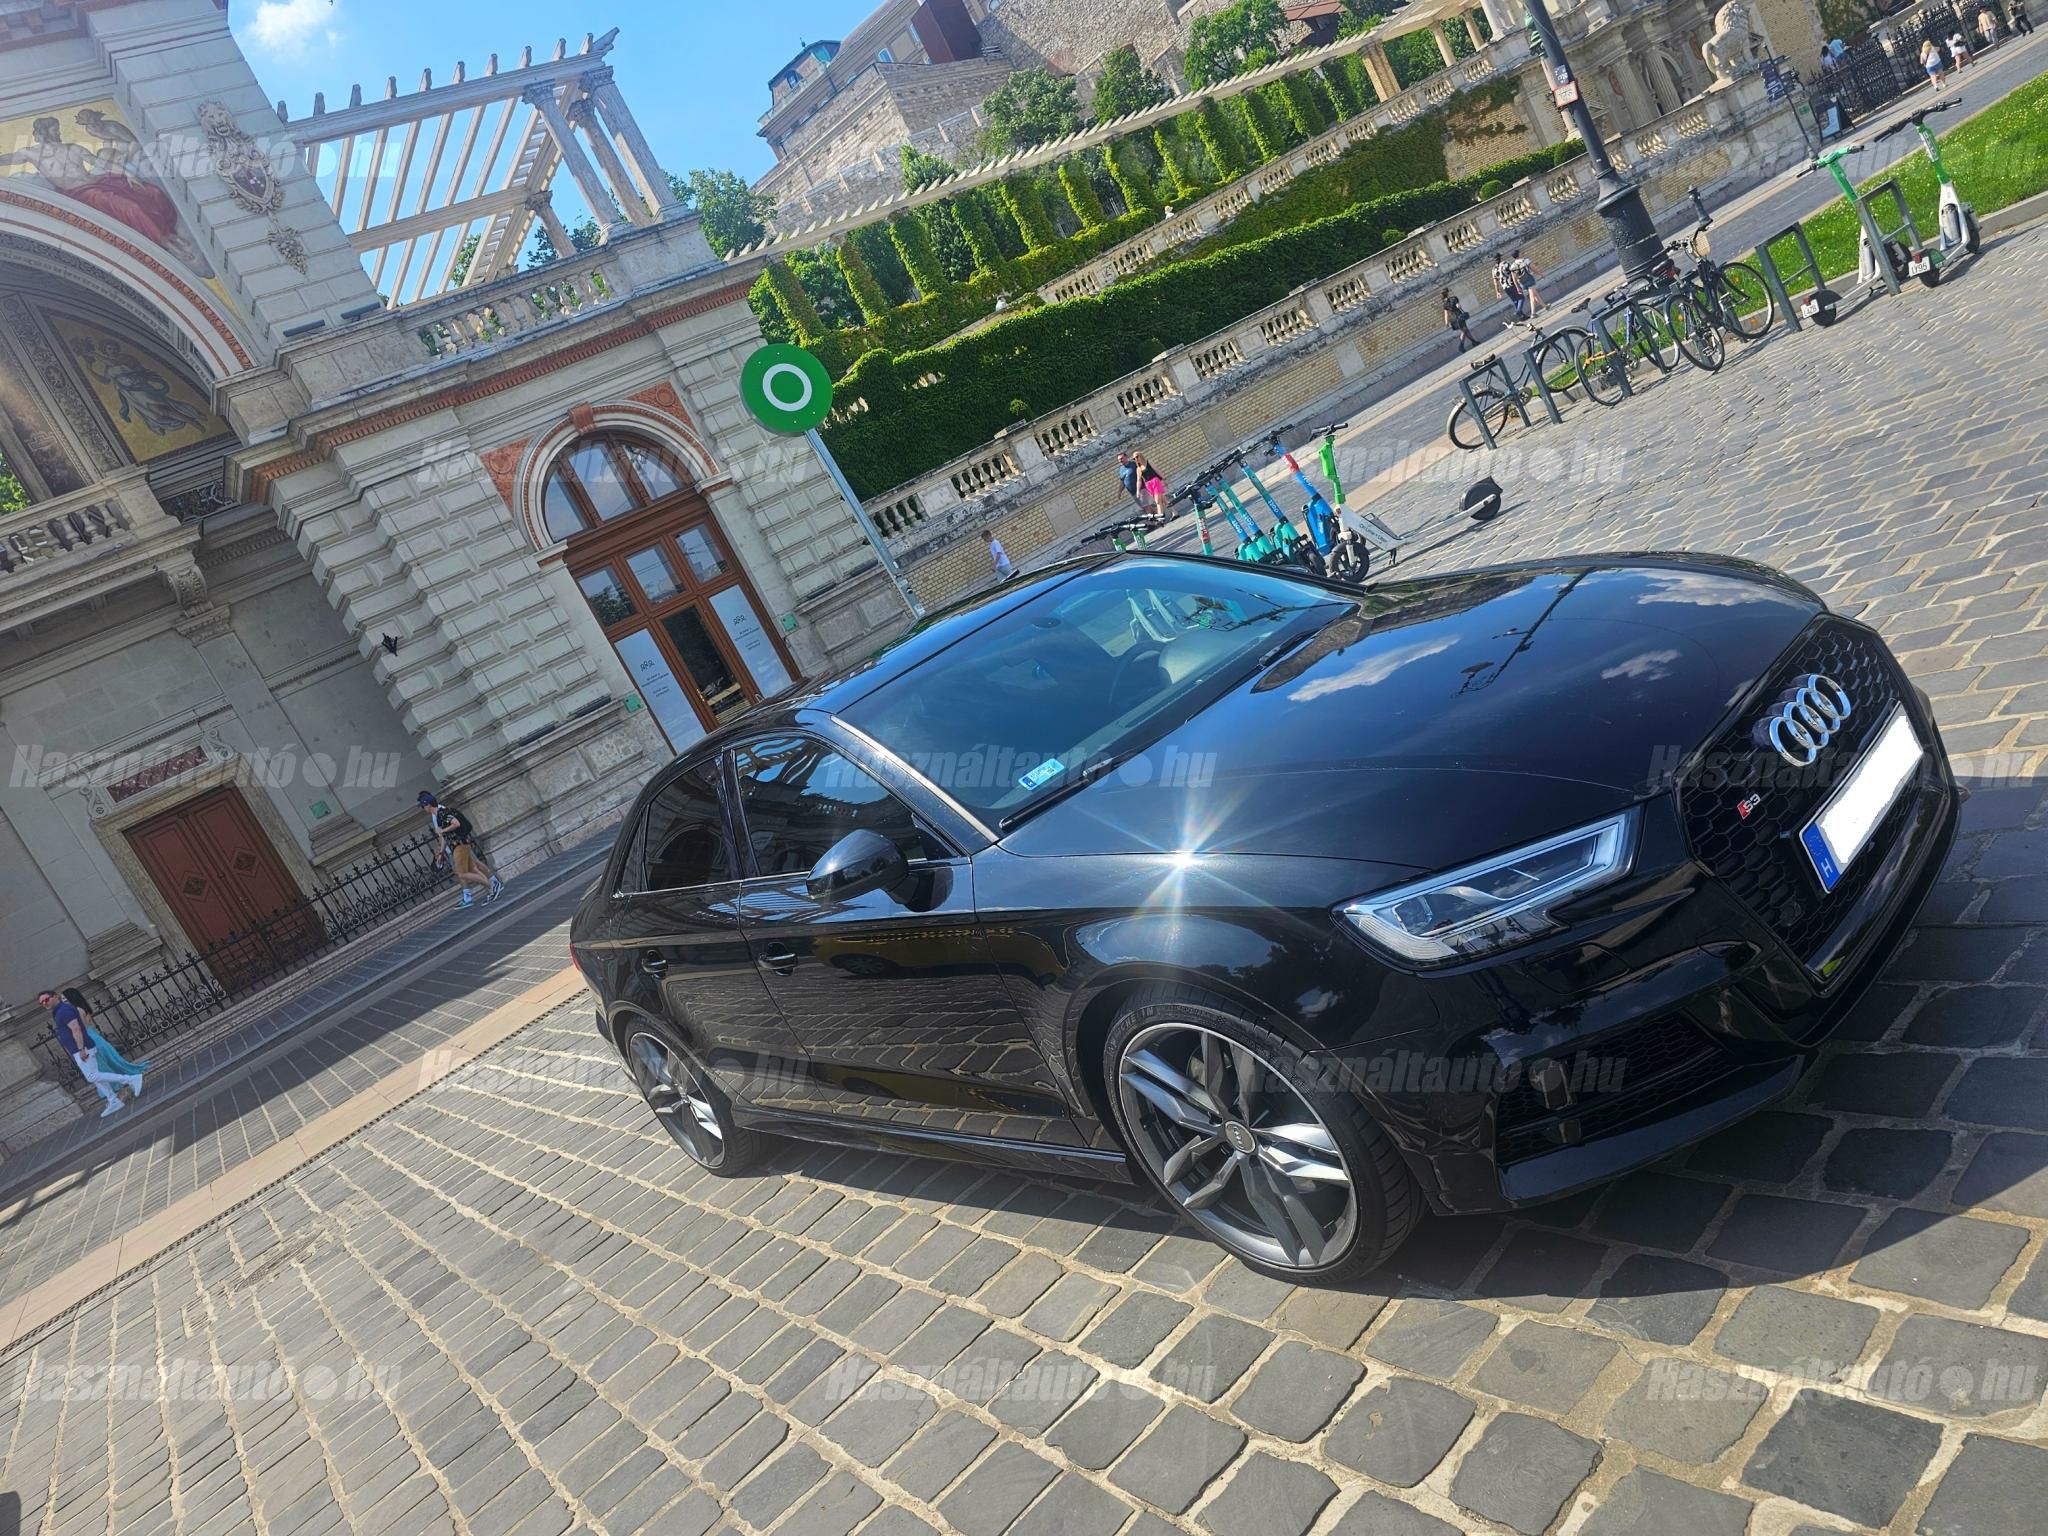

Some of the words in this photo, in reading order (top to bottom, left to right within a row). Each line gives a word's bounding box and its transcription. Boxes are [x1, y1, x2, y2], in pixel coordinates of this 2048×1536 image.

[1267, 499, 1280, 514] dott
[1231, 519, 1243, 535] dott
[1242, 512, 1256, 528] dott
[1743, 793, 1761, 813] S3
[1821, 857, 1833, 878] H
[1112, 1007, 1154, 1039] ICHEIN
